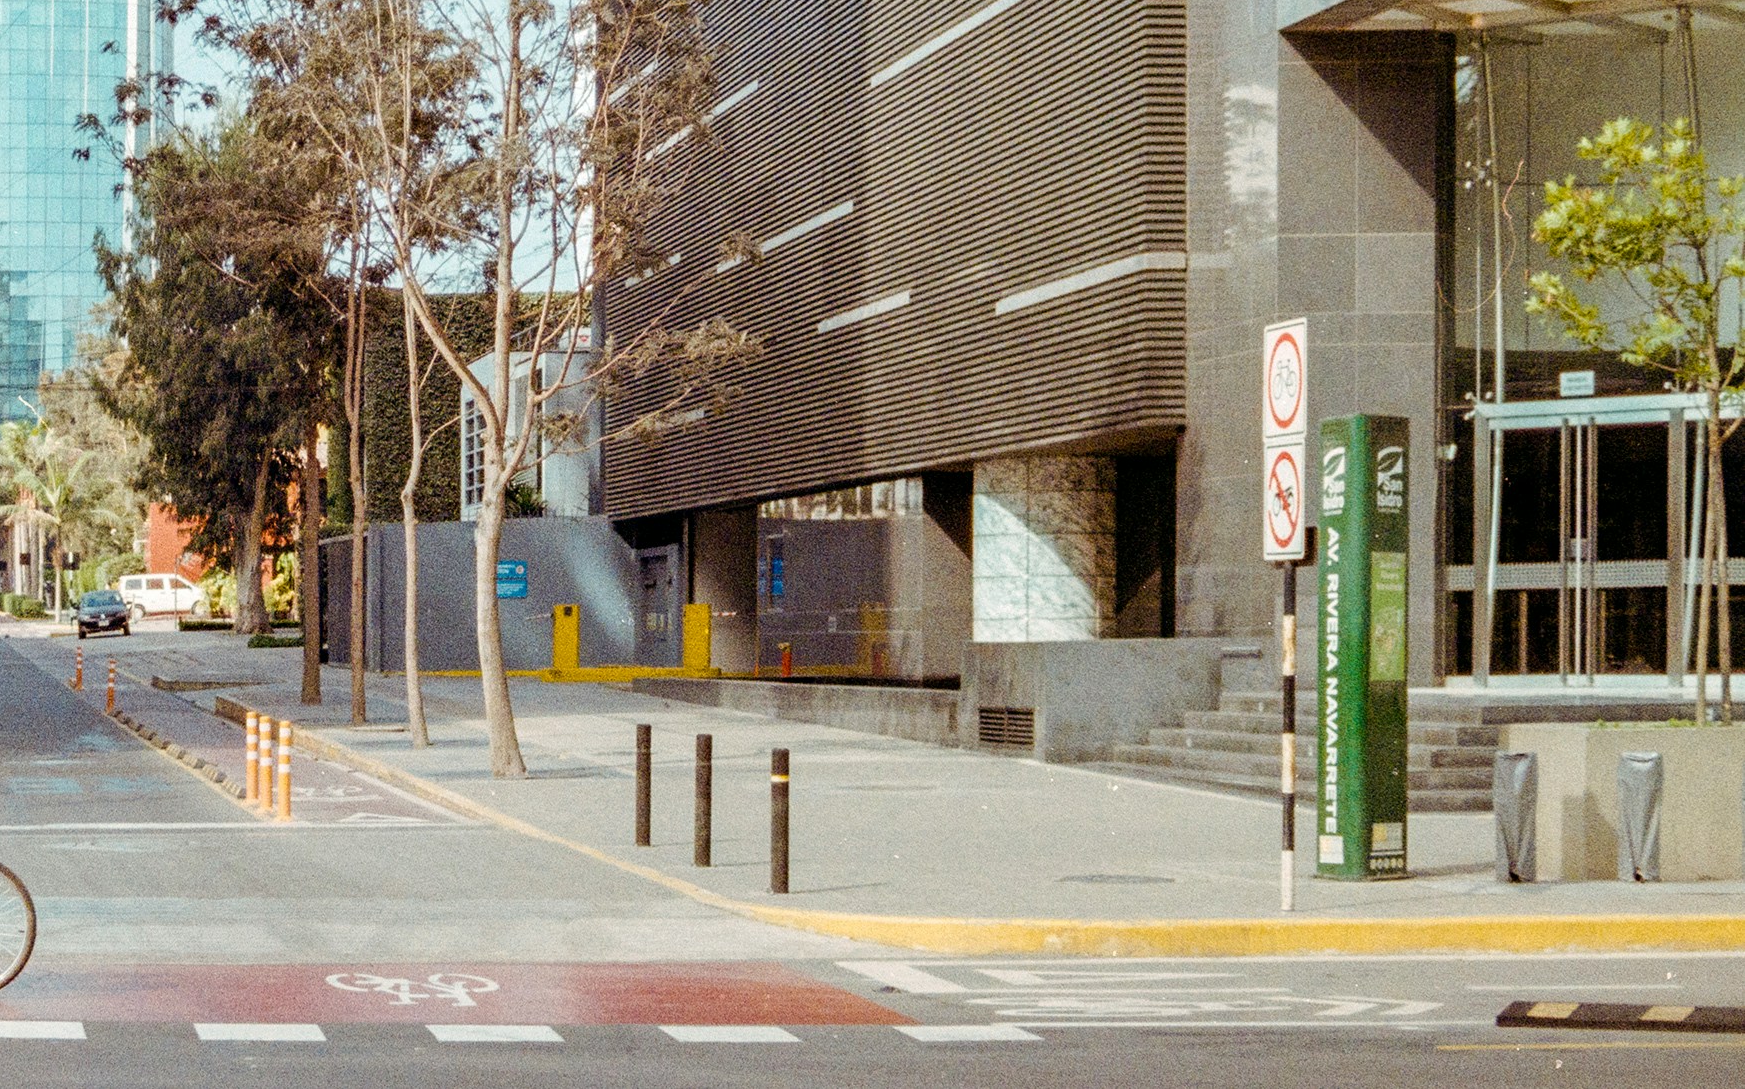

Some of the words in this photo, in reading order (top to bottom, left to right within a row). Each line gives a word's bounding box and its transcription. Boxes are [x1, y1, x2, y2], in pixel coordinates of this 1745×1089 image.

[1326, 526, 1340, 567] AV.
[1326, 573, 1340, 672] RIVERA
[1325, 677, 1339, 834] NAVARRETE
